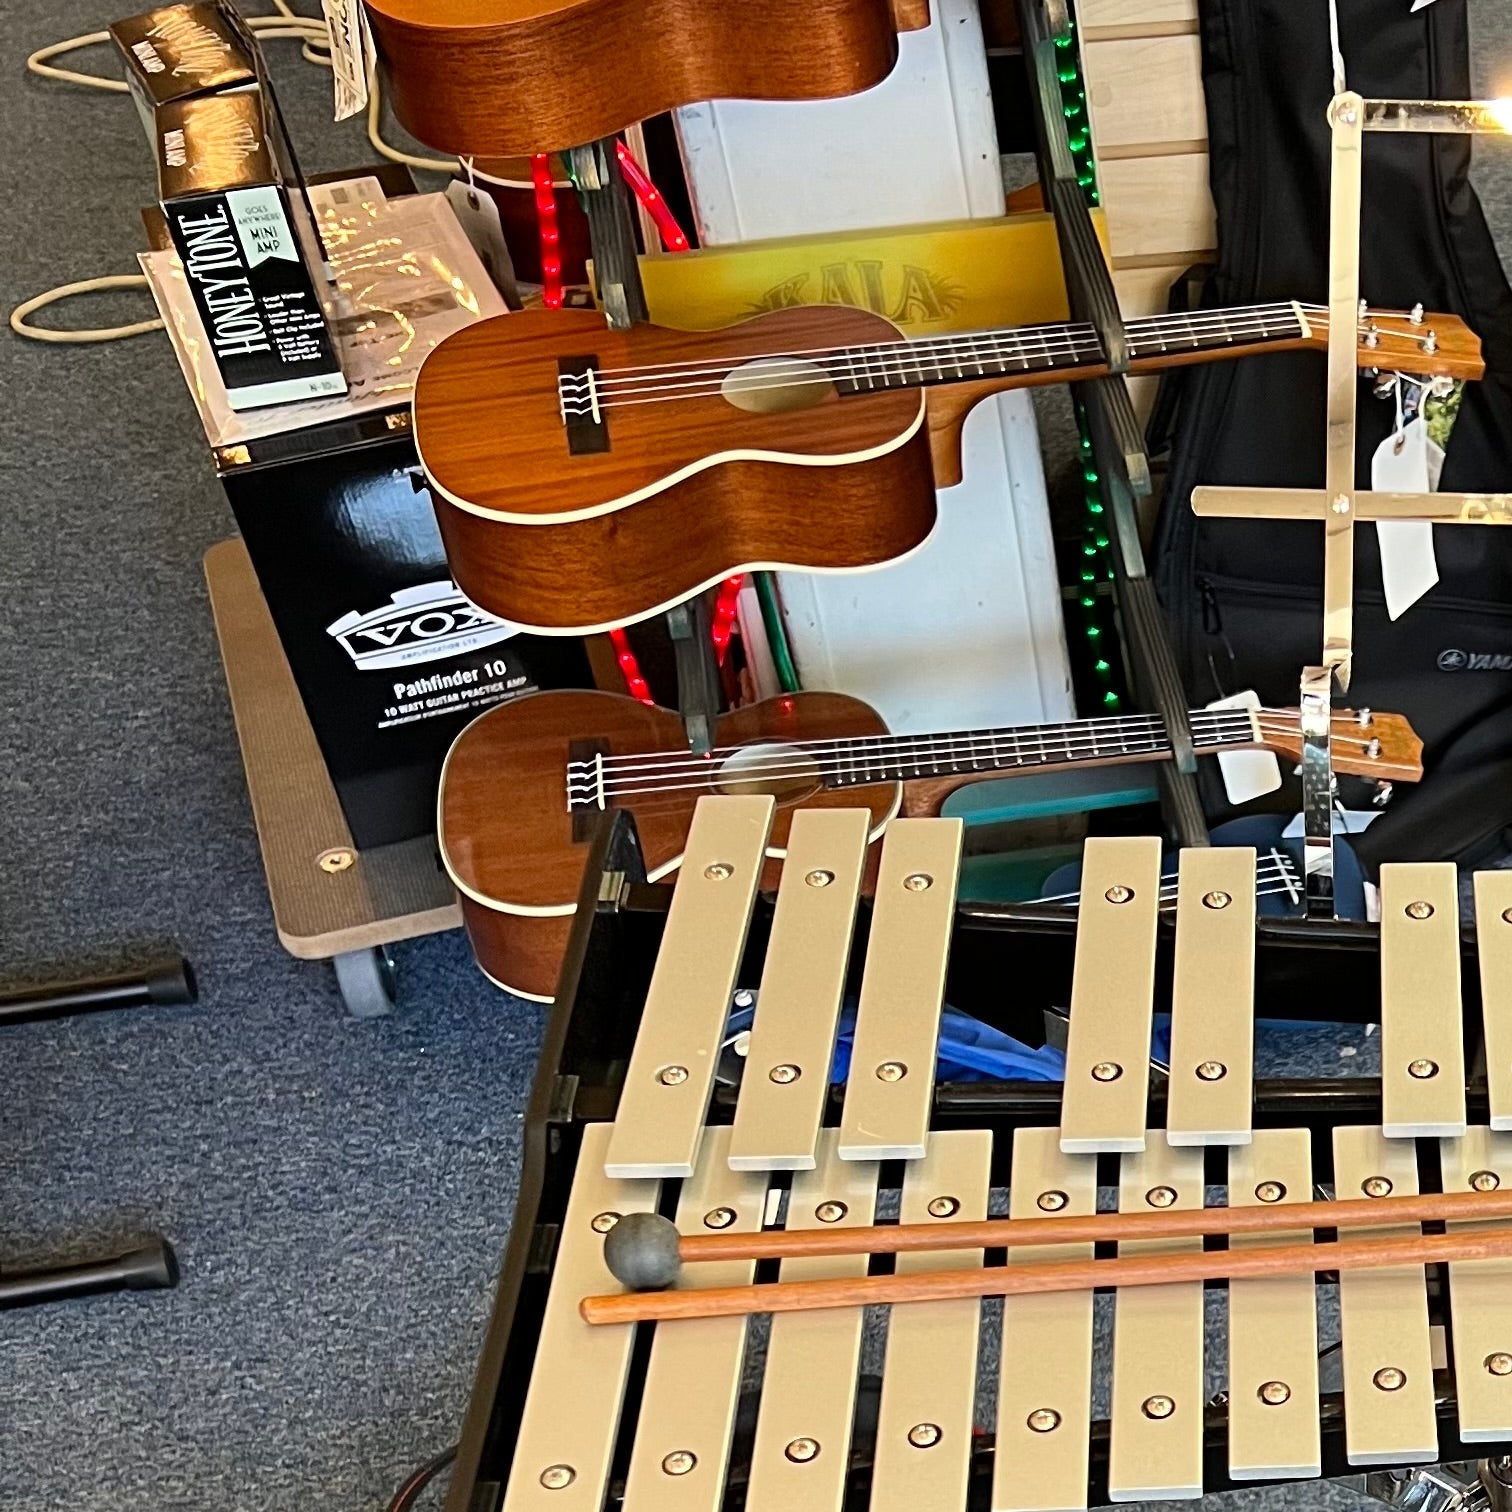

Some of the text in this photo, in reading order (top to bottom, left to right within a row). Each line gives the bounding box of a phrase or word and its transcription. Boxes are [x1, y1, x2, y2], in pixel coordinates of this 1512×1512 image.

[250, 226, 278, 241] MINI
[257, 239, 280, 254] AMP
[393, 660, 507, 699] Pathfinder 10
[384, 676, 527, 717] 10 WATT GUITAR PRACTICE AMP
